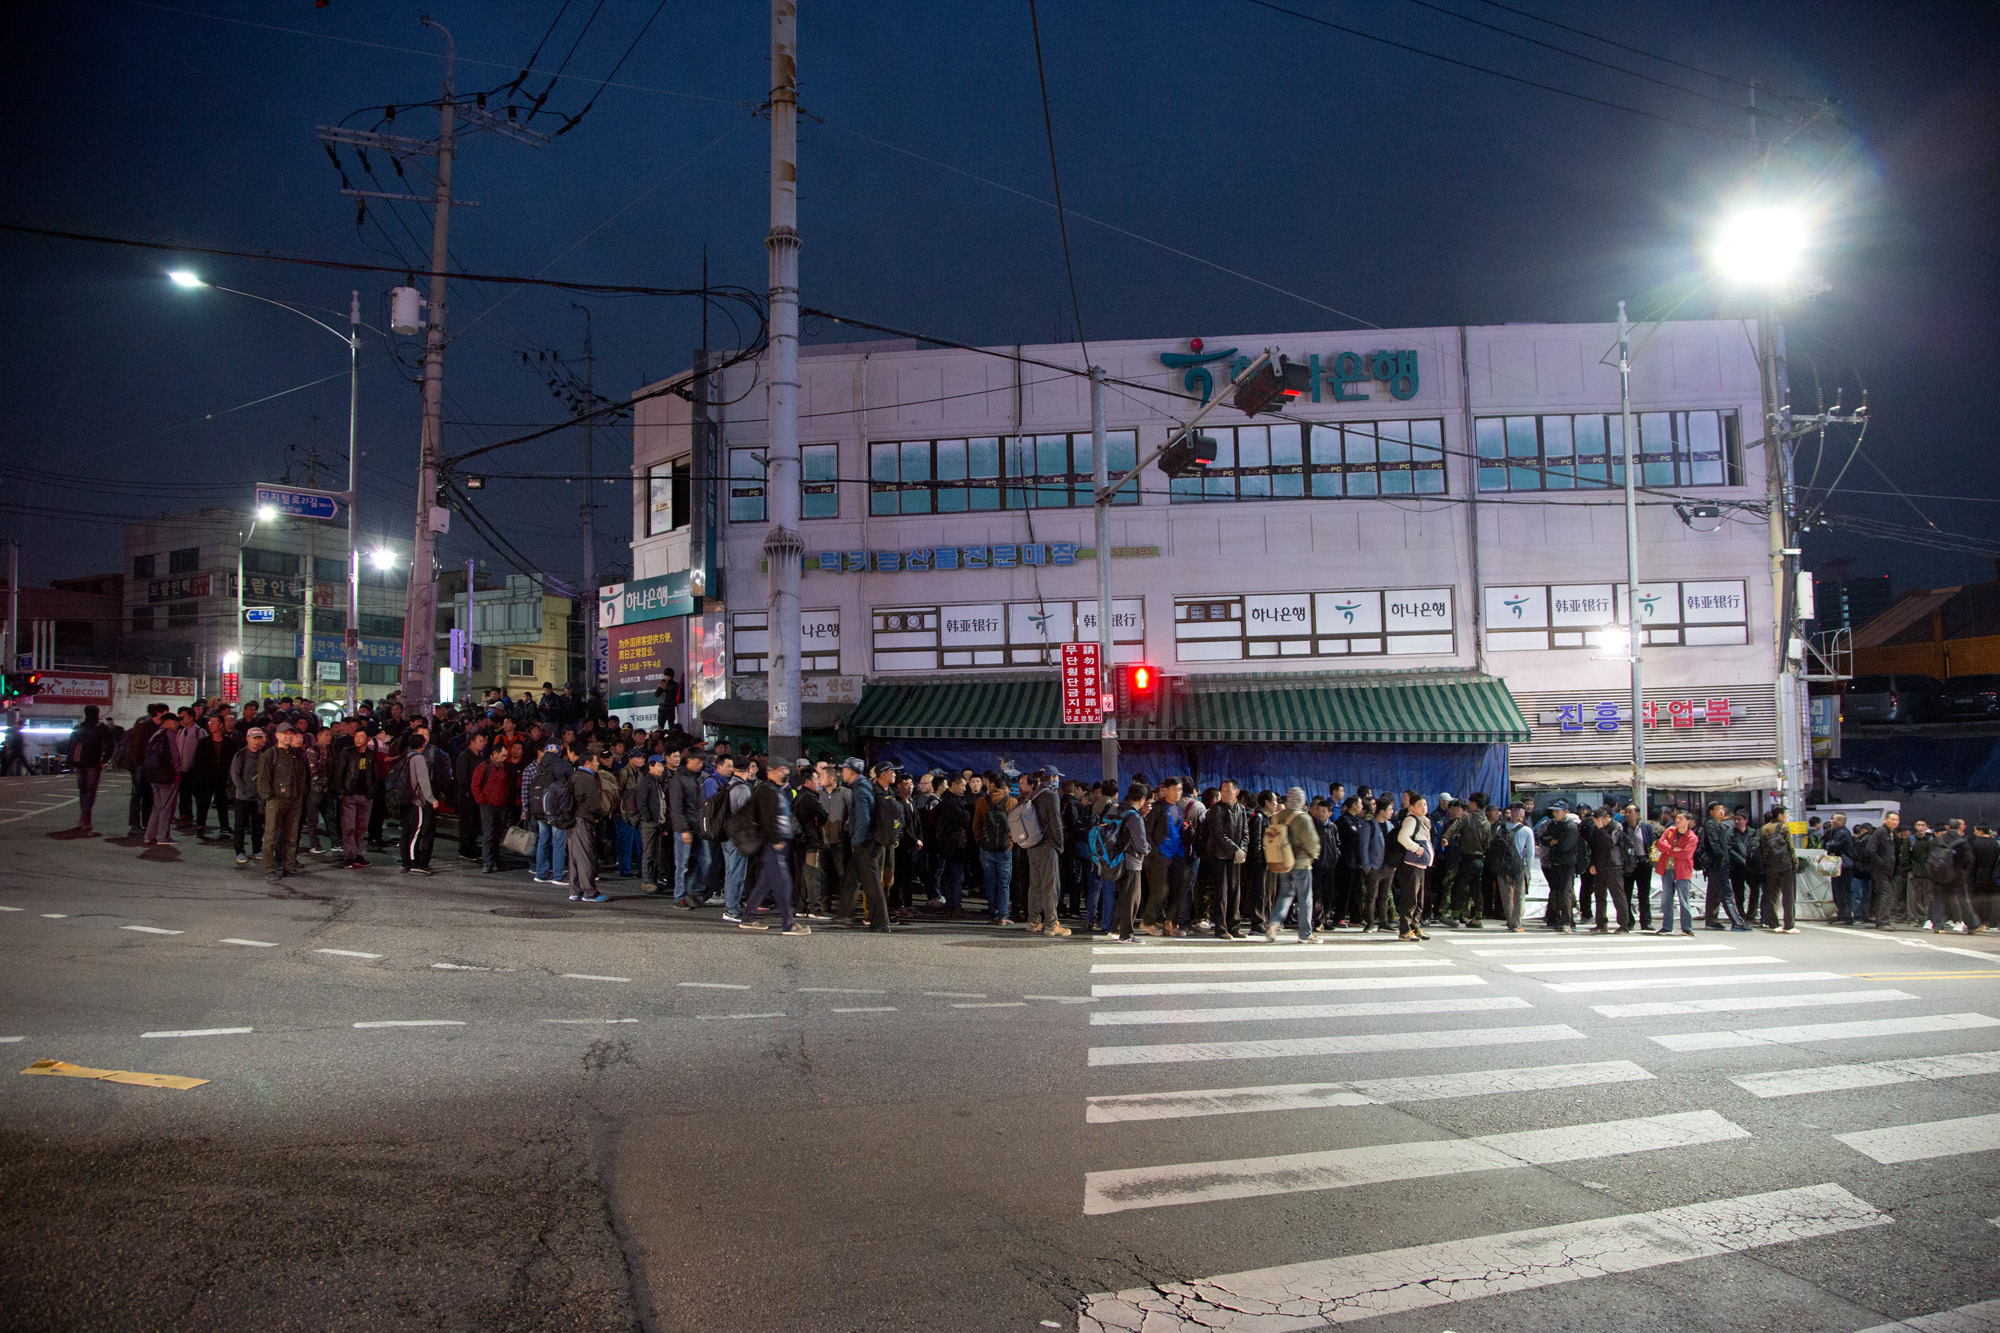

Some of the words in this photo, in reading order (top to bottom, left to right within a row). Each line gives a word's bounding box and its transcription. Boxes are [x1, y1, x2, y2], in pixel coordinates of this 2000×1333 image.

[1228, 349, 1419, 403] 은행
[1111, 547, 1153, 557] 53-7495
[626, 585, 668, 613] 하나은행
[1556, 599, 1609, 613] 韩亚银行
[1688, 595, 1740, 609] 韩亚银行
[1252, 606, 1306, 622] 하나은행
[1391, 602, 1445, 617] 하나은행
[946, 618, 999, 633] 韩亚银行
[1084, 613, 1137, 628] 韩银行
[802, 623, 839, 638] 나은행
[1065, 645, 1080, 707] 무단횡단금지
[38, 682, 56, 695] SK
[62, 686, 104, 697] telecom
[151, 678, 190, 694] 한성장
[827, 678, 853, 693] 생선
[1557, 701, 1622, 732] 진흥
[1643, 697, 1732, 729] 작업복
